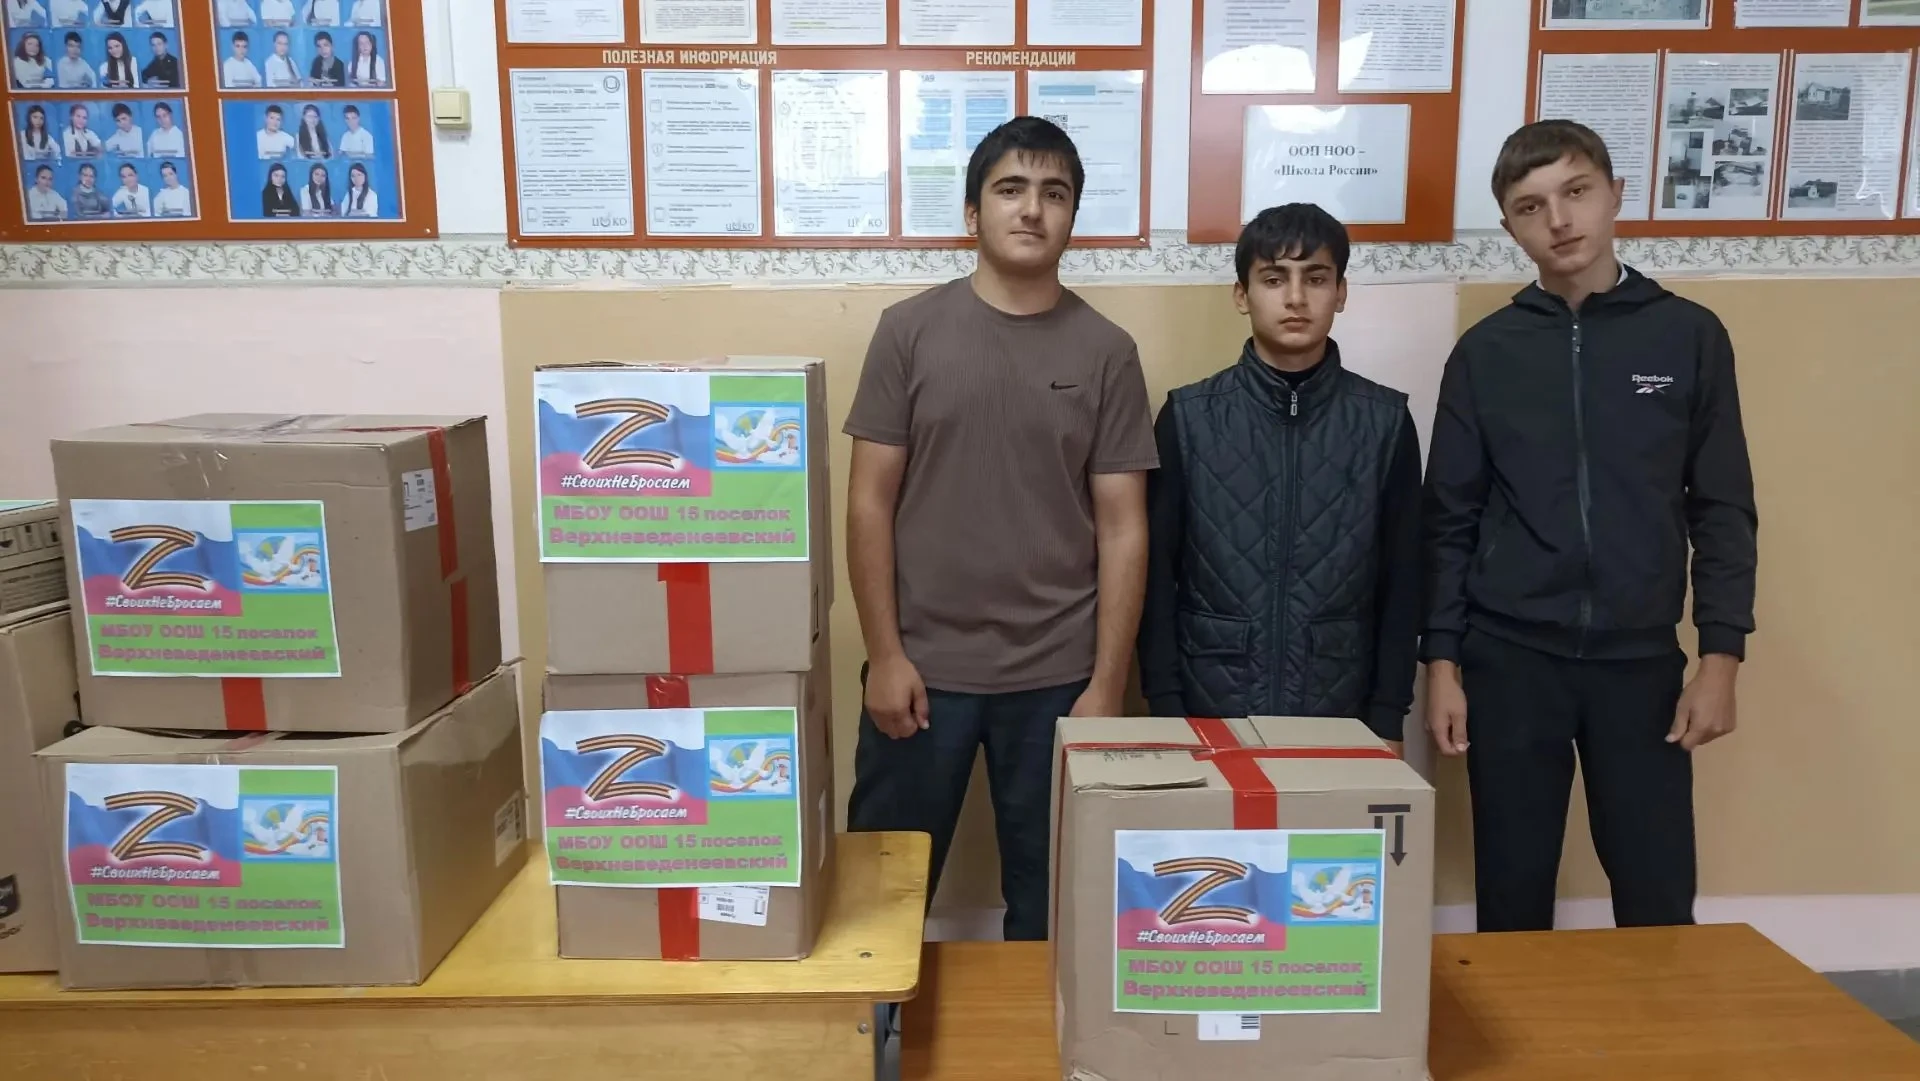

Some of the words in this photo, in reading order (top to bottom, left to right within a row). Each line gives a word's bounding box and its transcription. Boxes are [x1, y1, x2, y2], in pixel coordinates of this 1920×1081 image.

[602, 49, 675, 64] ПОЛЕЗНАЯ
[680, 50, 778, 66] ИНФОРМАЦИЯ
[966, 51, 1076, 67] РЕКОМЕНДАЦИИ
[1288, 145, 1320, 157] ООП
[1324, 145, 1356, 157] НОО
[1274, 164, 1325, 176] «Школа
[1329, 164, 1378, 176] России»
[1631, 374, 1674, 383] Reebok
[561, 474, 690, 491] #СвоихНеБросаем
[553, 505, 613, 521] МБОУ
[619, 505, 669, 521] ООШ
[677, 505, 699, 521] 15
[704, 508, 791, 521] поселок
[101, 624, 153, 638] МБОУ
[160, 624, 204, 639] ООШ
[212, 625, 233, 640] 15
[557, 835, 613, 850] МБОУ
[620, 834, 668, 849] ООШ
[675, 833, 697, 848] 15
[87, 892, 145, 907] МБОУ
[208, 894, 231, 909] 15
[1128, 959, 1186, 975] МБОУ
[1193, 959, 1244, 975] ООШ
[1251, 959, 1274, 975] 15
